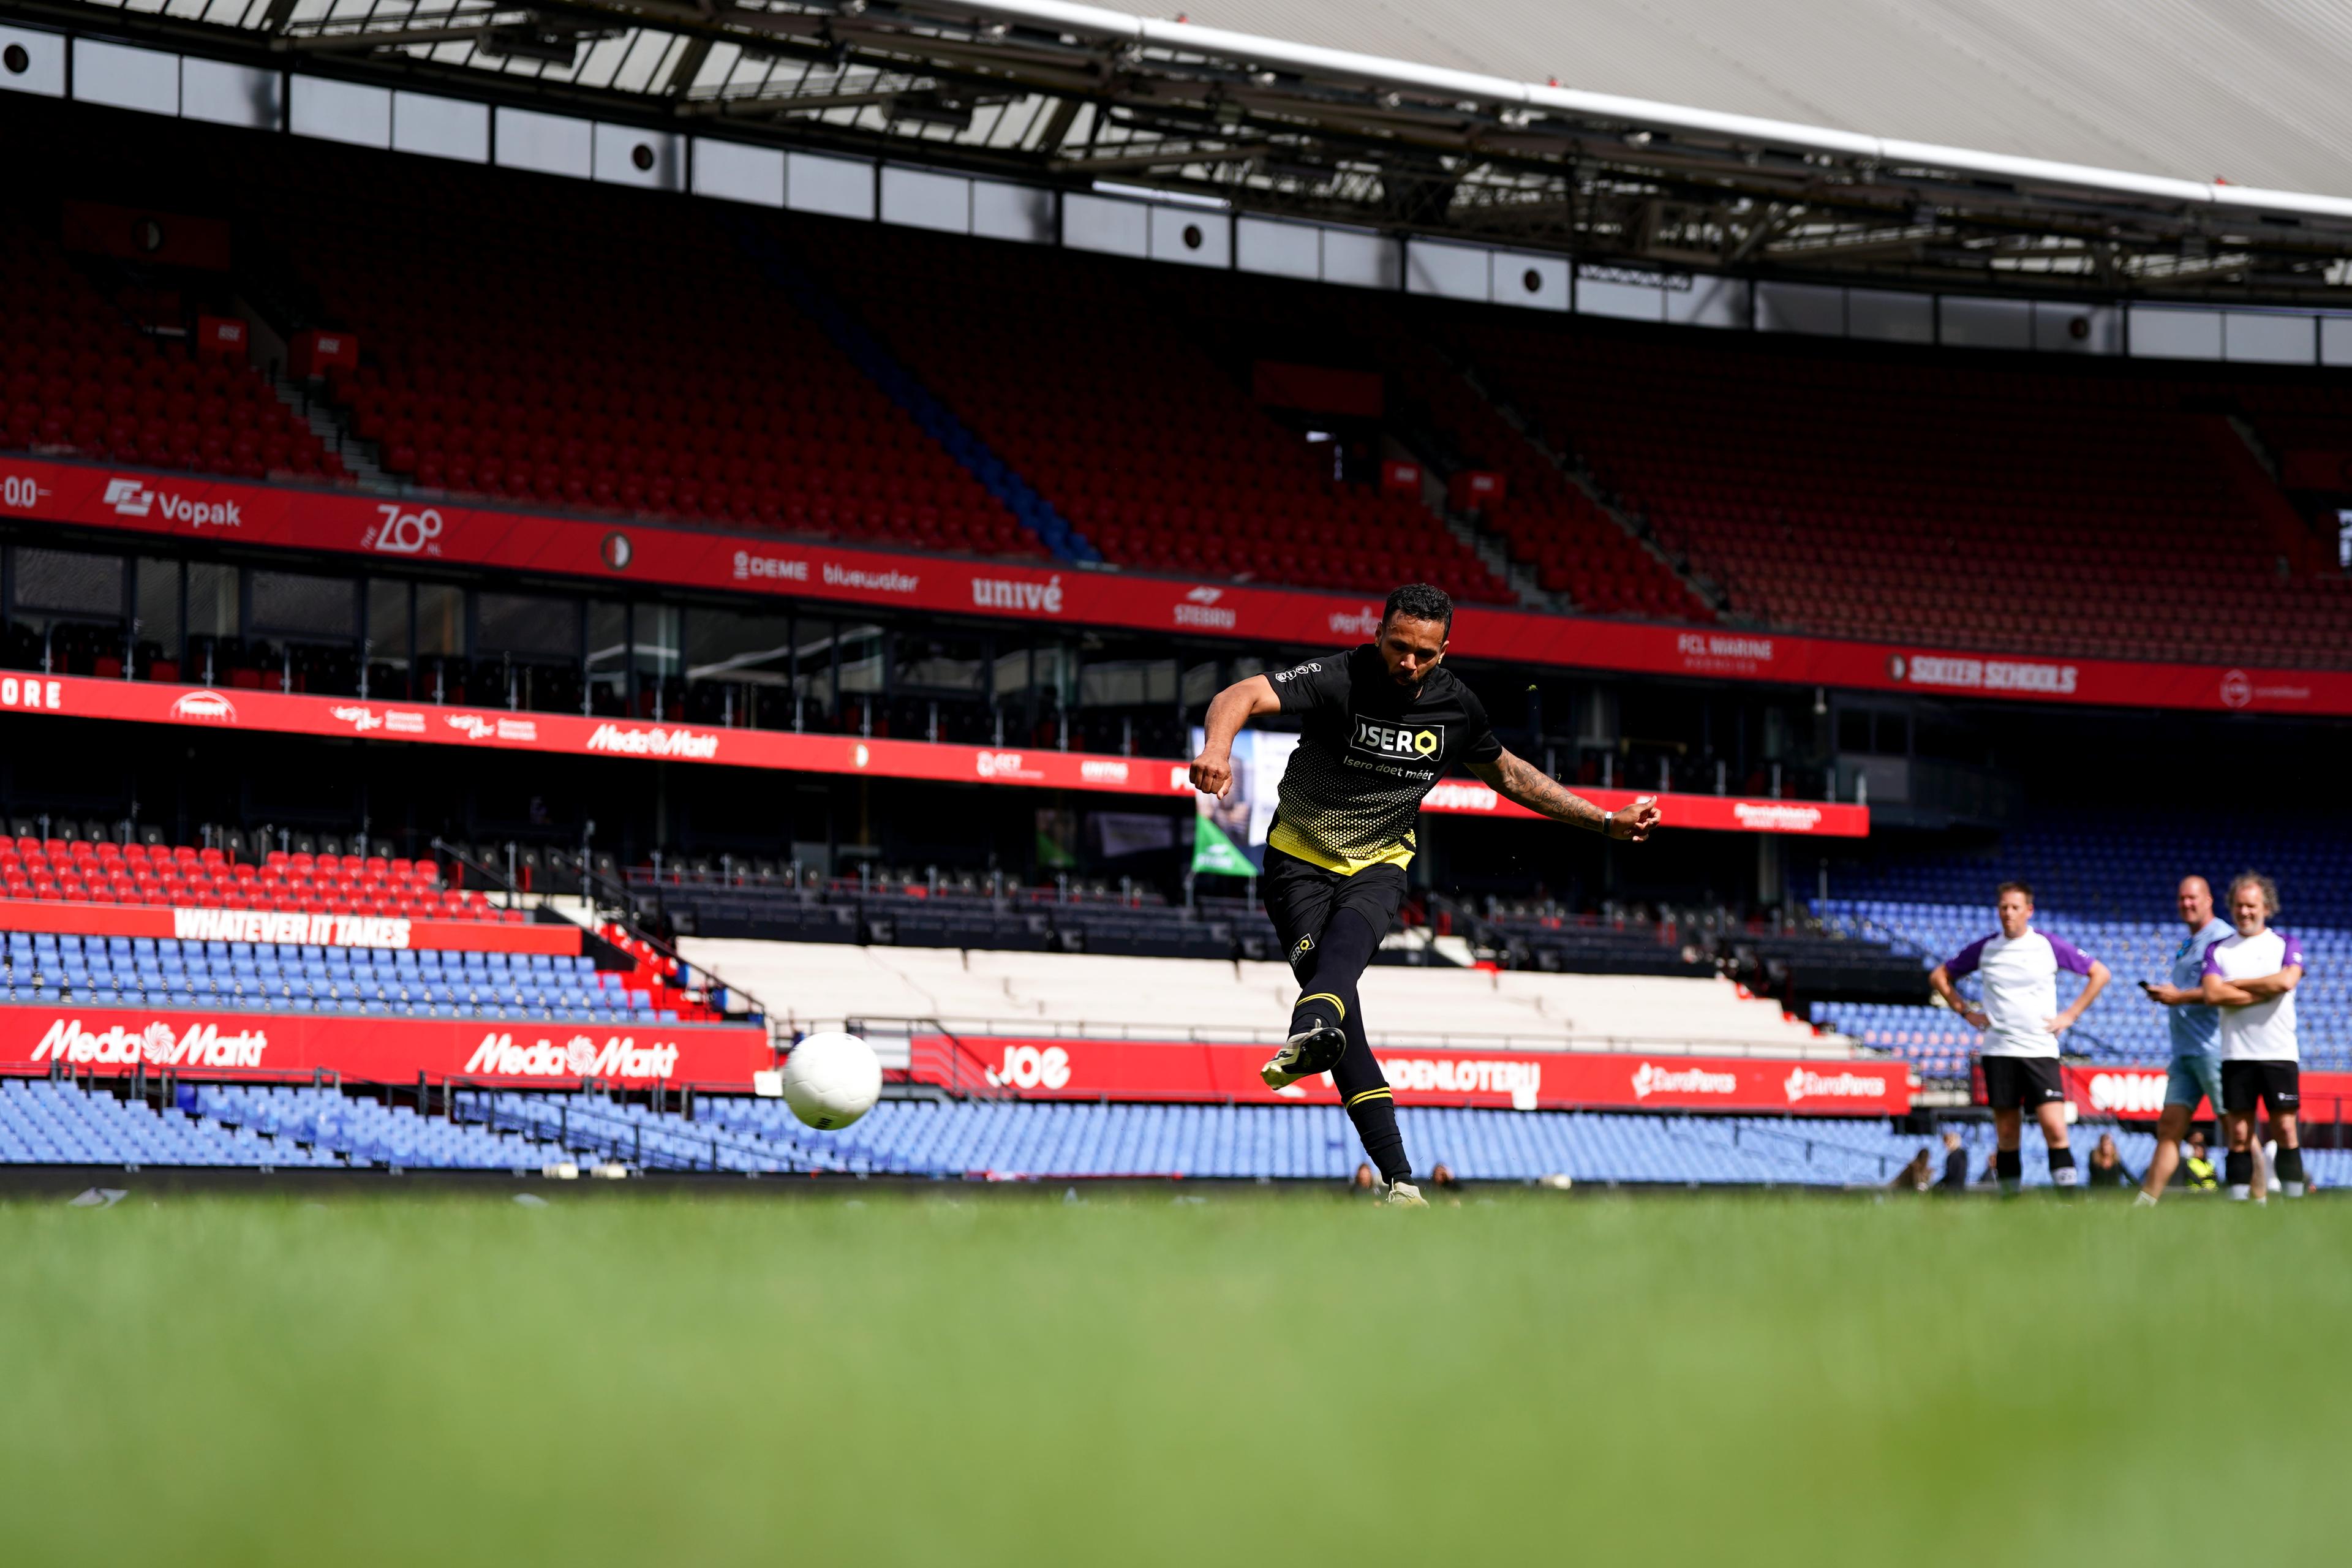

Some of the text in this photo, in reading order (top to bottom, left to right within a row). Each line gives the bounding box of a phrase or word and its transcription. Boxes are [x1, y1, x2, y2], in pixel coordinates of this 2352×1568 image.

[158, 492, 241, 529] Vopak
[750, 556, 809, 581] DEME
[823, 562, 919, 592] bluewater
[970, 575, 1063, 612] univé
[1173, 603, 1236, 630] STEBRU
[1709, 636, 1773, 660] MARINE
[1909, 655, 2078, 694] SOCCER SCHOOLS
[1358, 723, 1437, 755] ISERO
[1343, 755, 1434, 781] Isero doet méér
[174, 907, 412, 949] WHATEVER IT TAKES
[1651, 1066, 1737, 1095] EuroParcs
[1804, 1070, 1887, 1098] EuroParcs
